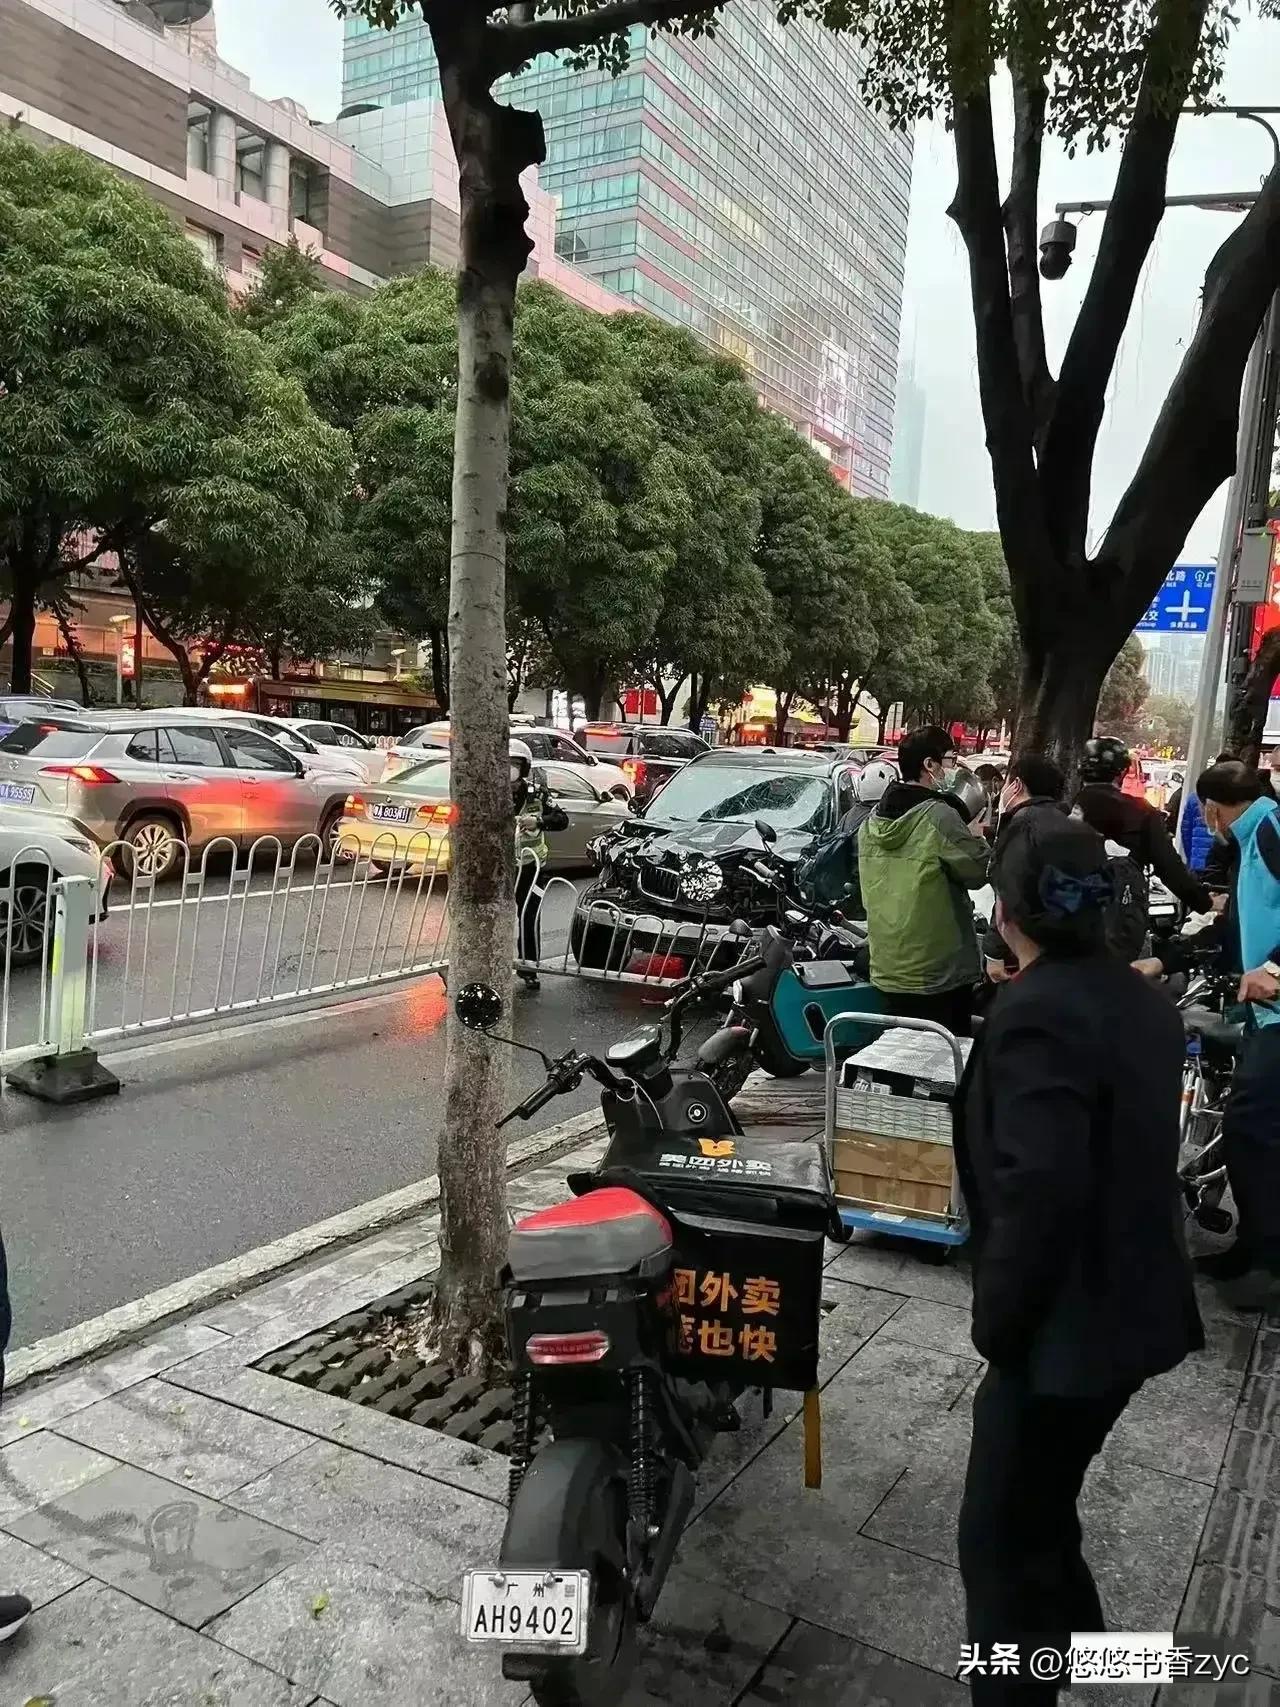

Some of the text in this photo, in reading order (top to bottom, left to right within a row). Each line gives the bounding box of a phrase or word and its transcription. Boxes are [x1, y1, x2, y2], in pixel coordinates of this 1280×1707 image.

[659, 1153, 772, 1171] 美团外卖
[473, 1604, 574, 1635] AH9402
